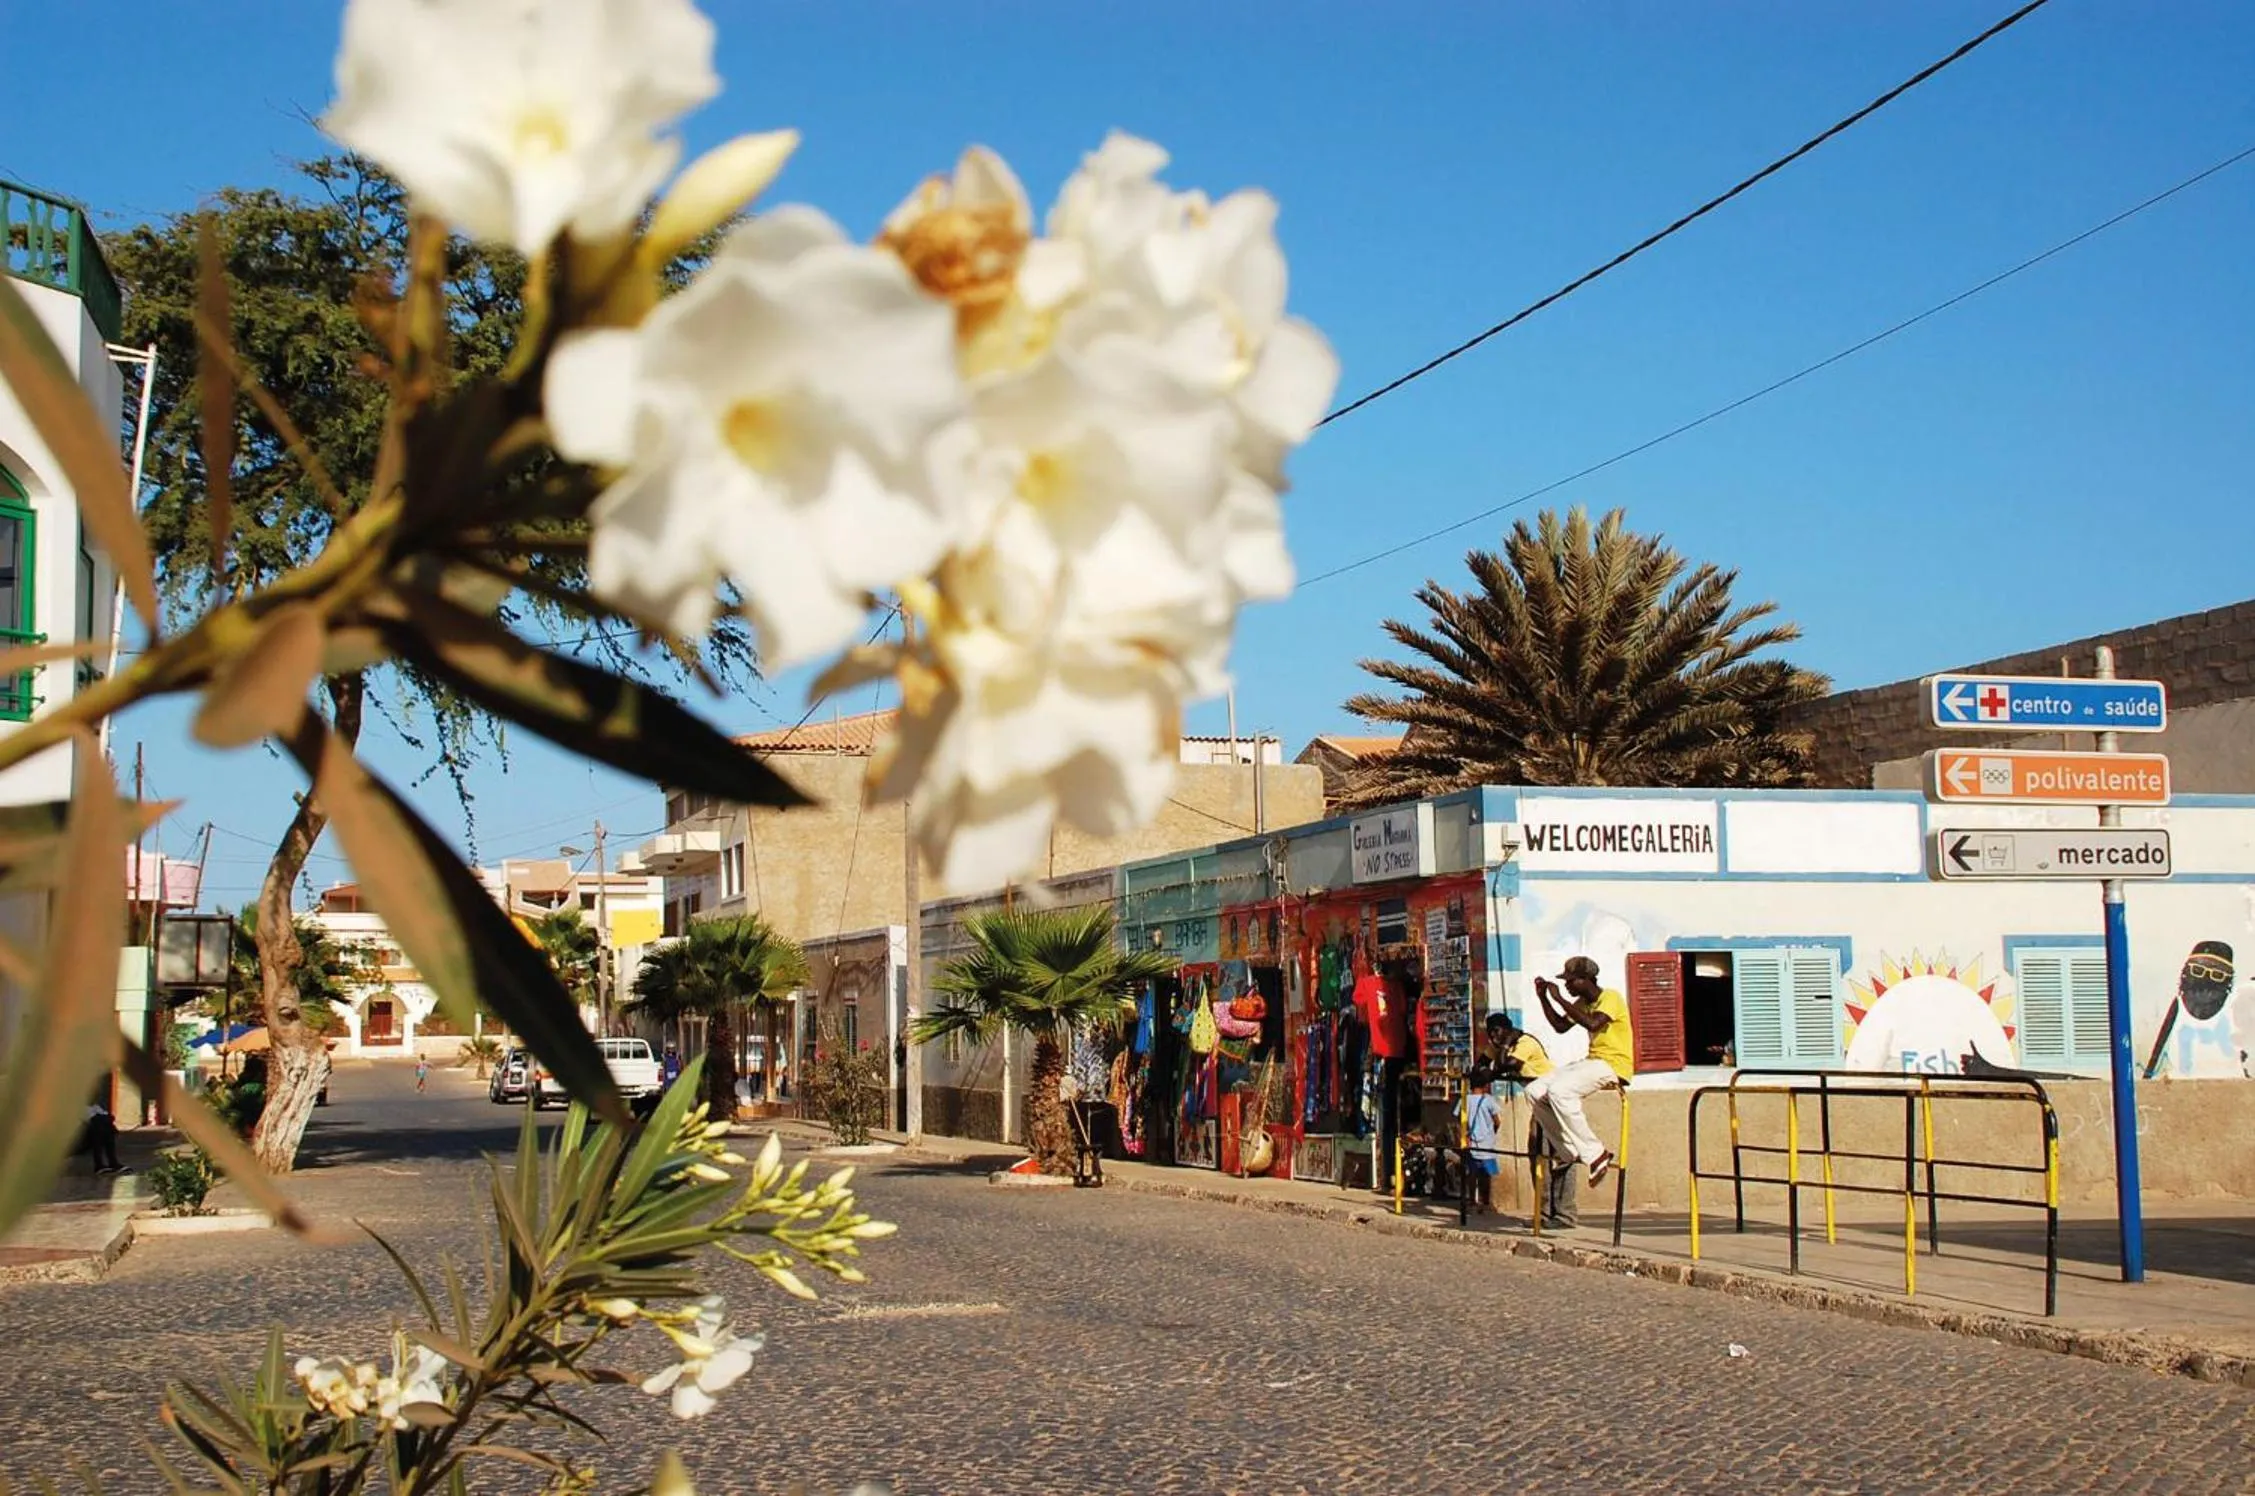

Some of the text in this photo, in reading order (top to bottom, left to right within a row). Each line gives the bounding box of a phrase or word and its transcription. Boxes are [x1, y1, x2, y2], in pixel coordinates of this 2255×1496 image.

[2011, 695, 2159, 716] centro de saúde
[2025, 768, 2162, 793] polivalente
[2058, 842, 2165, 866] mercado
